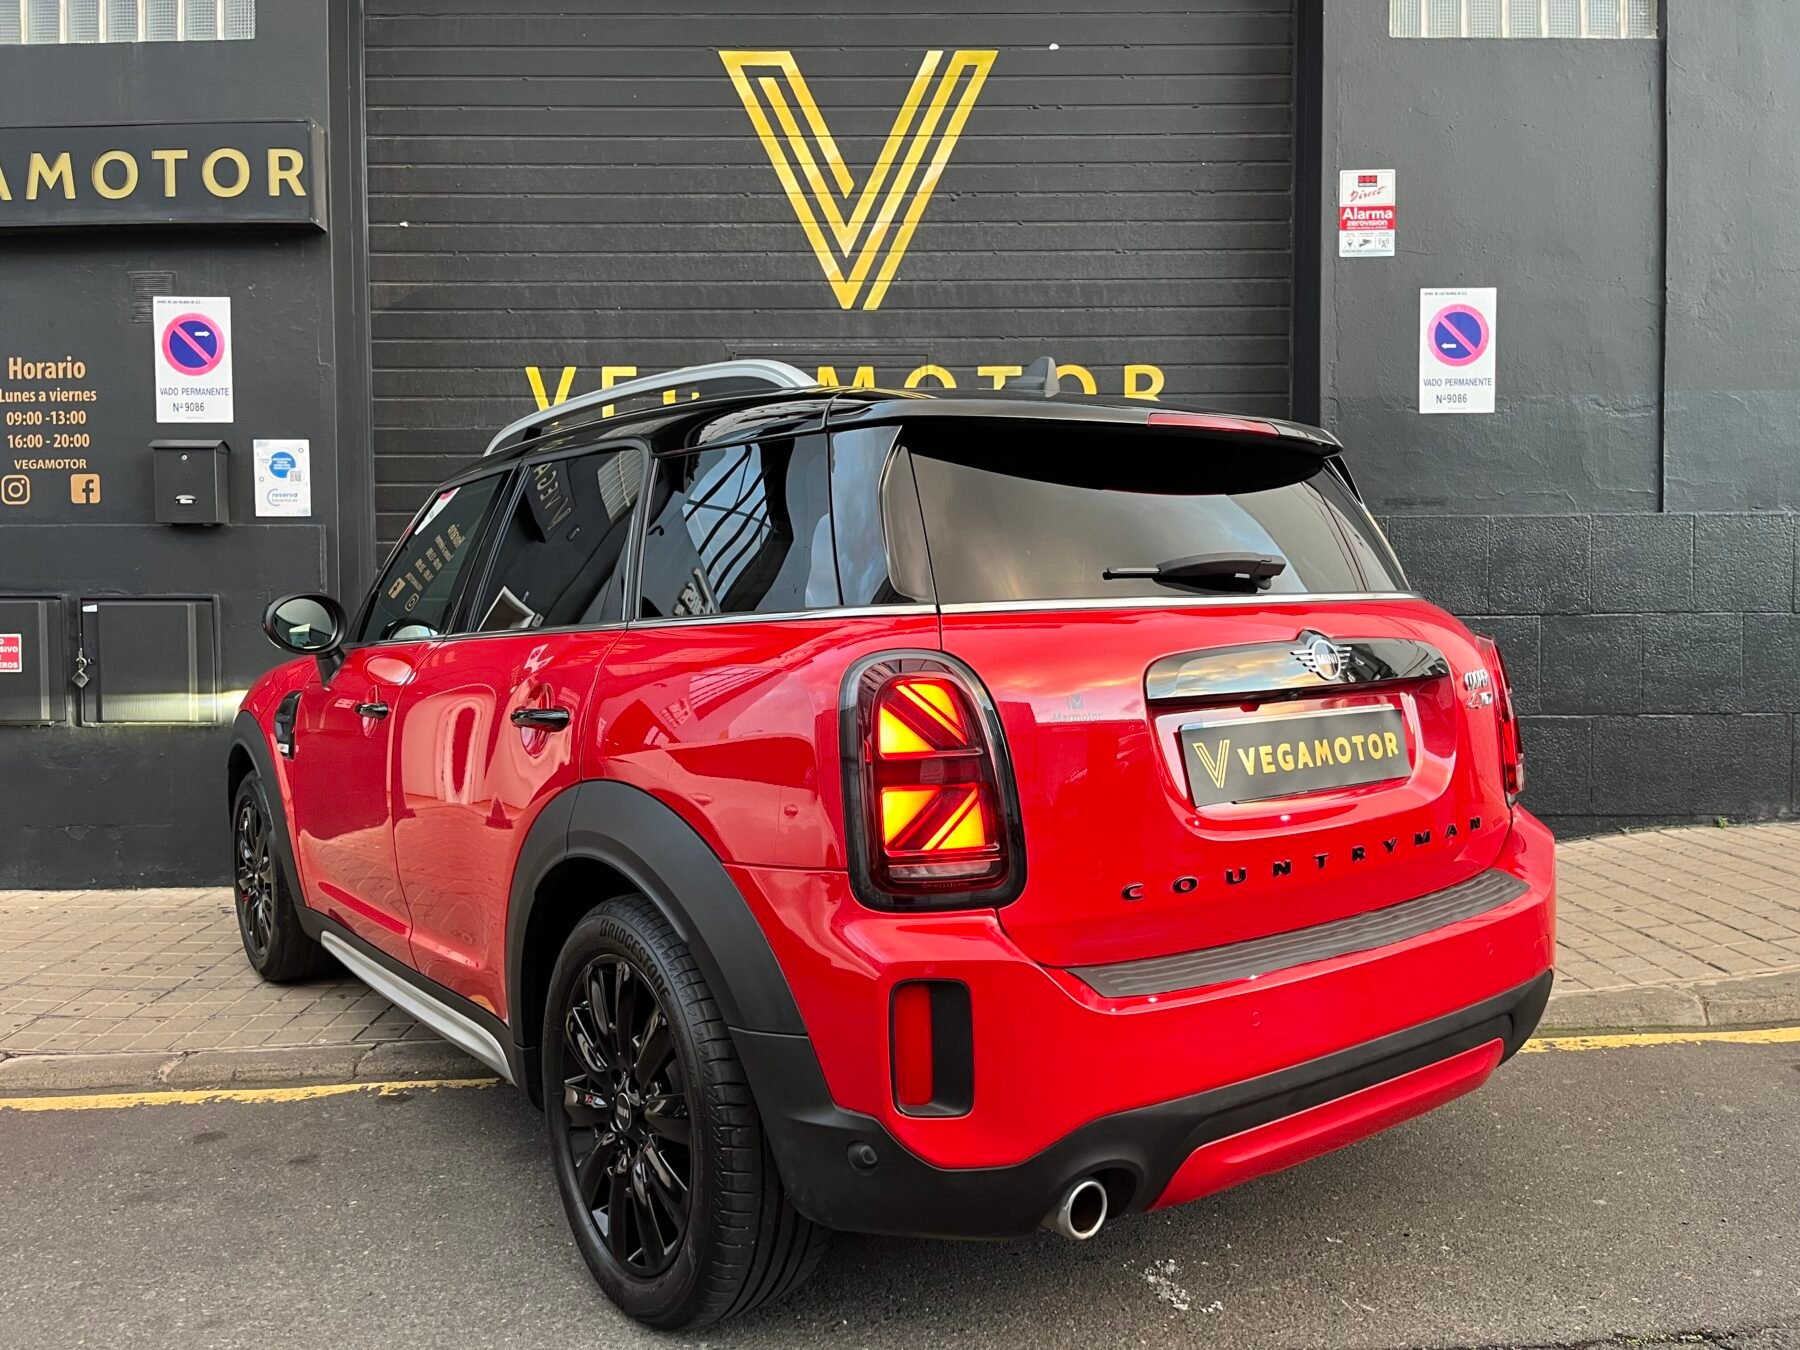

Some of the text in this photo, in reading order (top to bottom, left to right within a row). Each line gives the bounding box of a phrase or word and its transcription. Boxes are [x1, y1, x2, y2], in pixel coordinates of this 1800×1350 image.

[1342, 207, 1393, 220] Alarma
[8, 356, 86, 380] Horario
[1423, 377, 1492, 387] VADO PERMANENTE
[38, 391, 46, 402] a
[50, 387, 97, 402] viernes
[160, 387, 230, 396] VADO PERMANENTE
[6, 411, 43, 425] 09:00
[7, 434, 43, 448] 16:00
[53, 433, 90, 448] 20:00
[14, 458, 87, 470] VEGAMOTOR
[1236, 731, 1400, 776] VEGAMOTOR
[1121, 816, 1482, 901] COUNTRYMAN
[599, 918, 671, 1001] BRIDGESTONE
